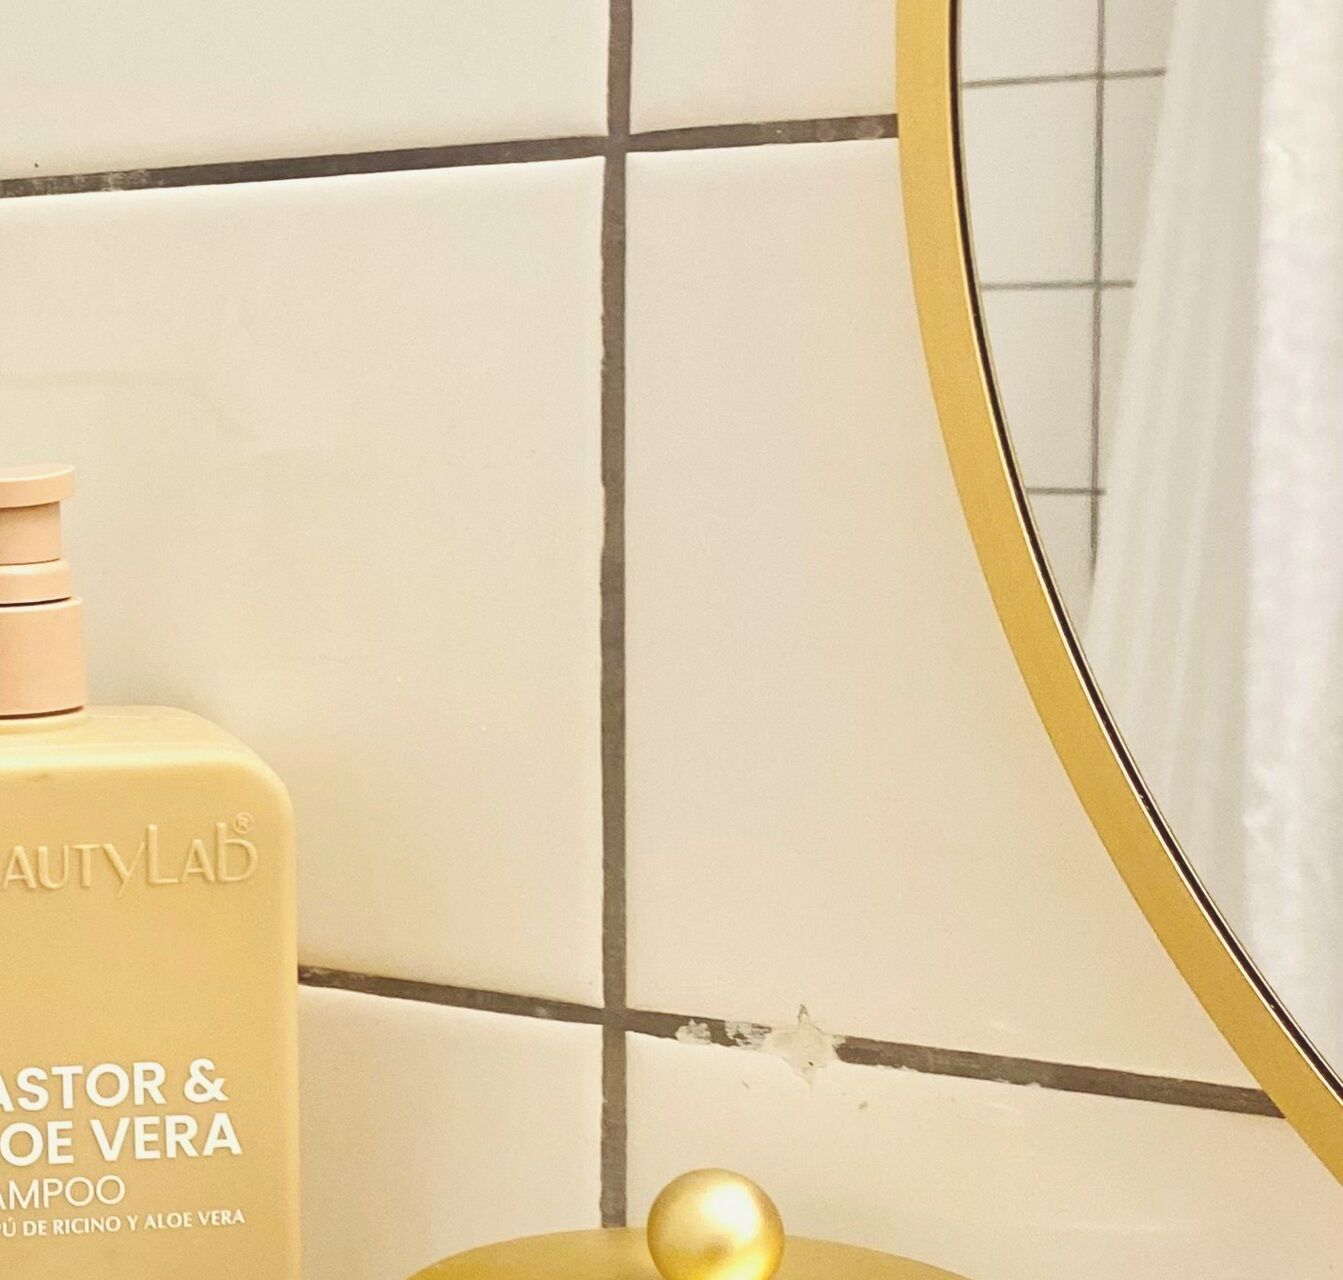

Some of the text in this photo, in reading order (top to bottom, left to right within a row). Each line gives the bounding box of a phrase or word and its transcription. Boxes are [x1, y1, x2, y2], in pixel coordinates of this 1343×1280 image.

[183, 1057, 229, 1103] &
[90, 1112, 243, 1162] VERA
[23, 1220, 47, 1237] DE
[52, 1215, 121, 1235] RICINO
[126, 1215, 139, 1231] Y
[143, 1212, 193, 1229] ALOE
[197, 1208, 246, 1226] VERA
